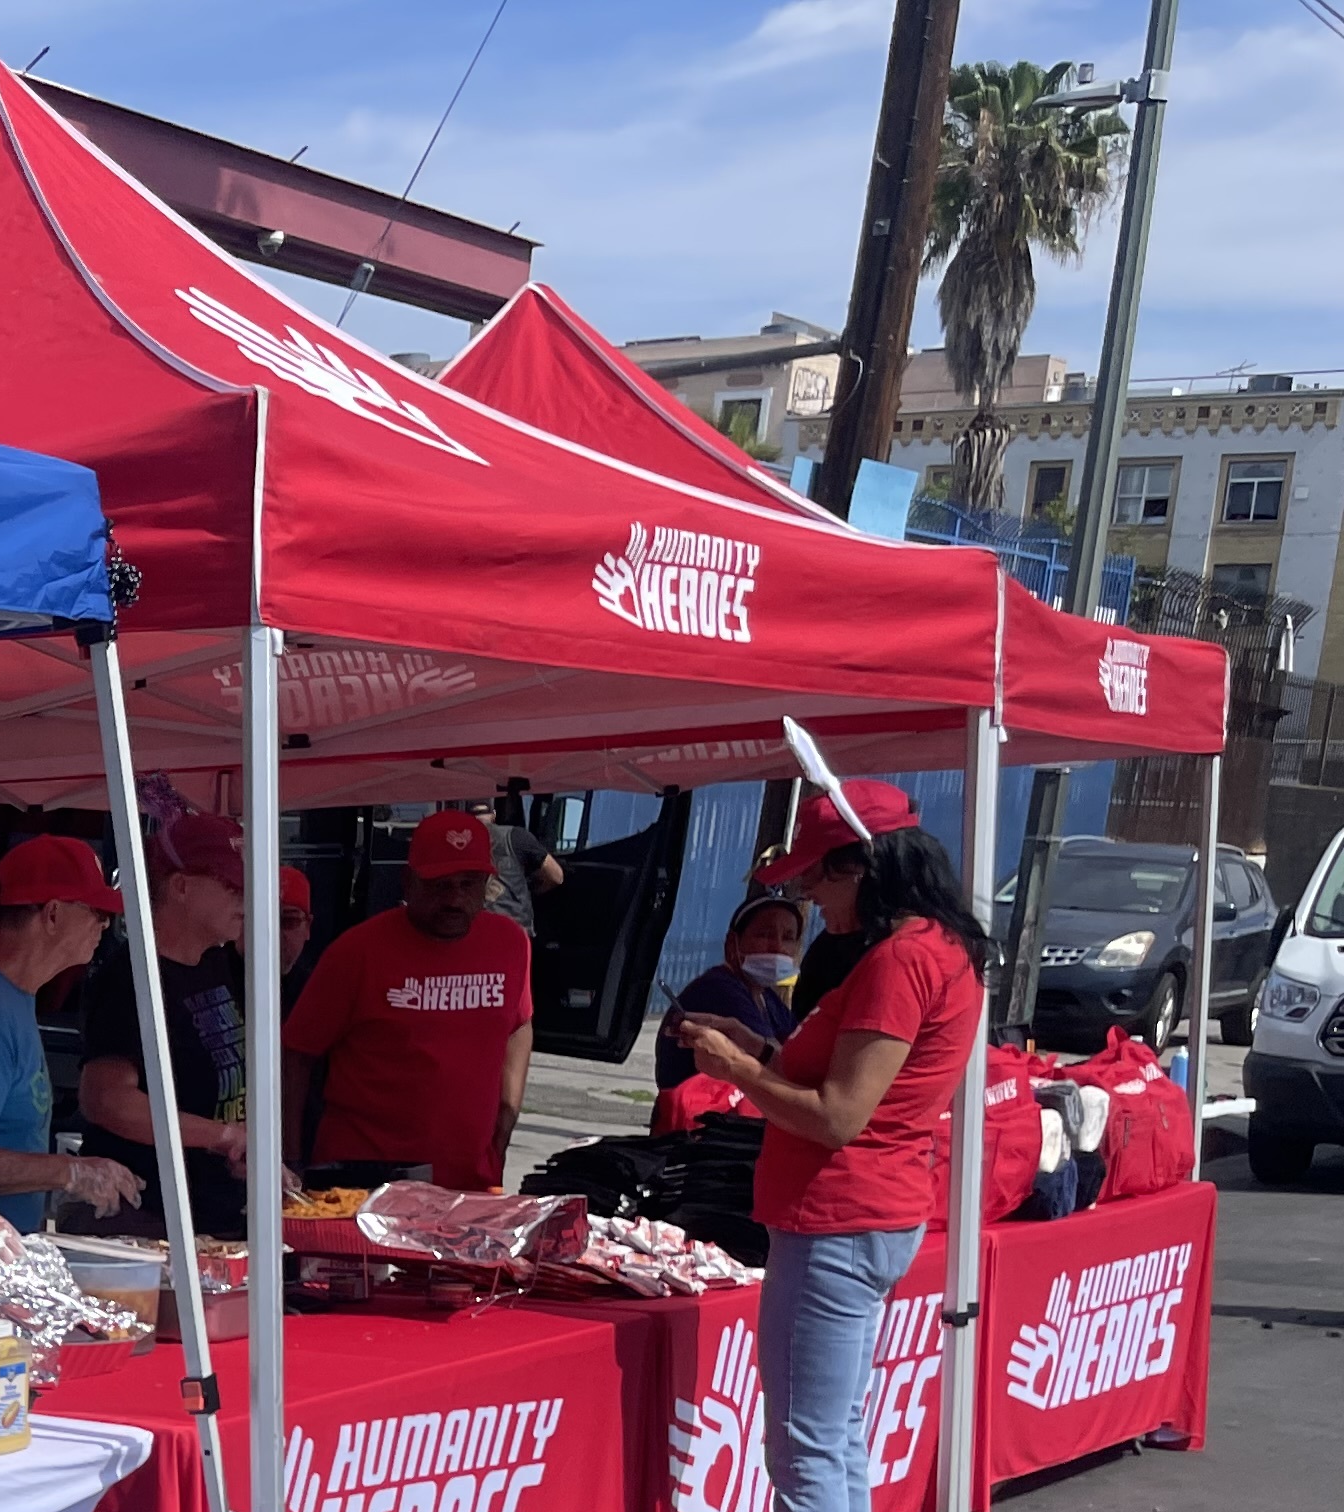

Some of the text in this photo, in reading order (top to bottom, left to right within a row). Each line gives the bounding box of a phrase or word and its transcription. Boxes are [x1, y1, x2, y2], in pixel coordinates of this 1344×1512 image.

[647, 525, 761, 577] HUMANITY
[639, 562, 755, 643] HEROES
[422, 985, 505, 1011] HEROES
[424, 973, 505, 989] HUMANITY
[1073, 1242, 1193, 1315] HUMANITY
[1048, 1287, 1184, 1409] HEROES
[327, 1398, 564, 1494] HUMANITY
